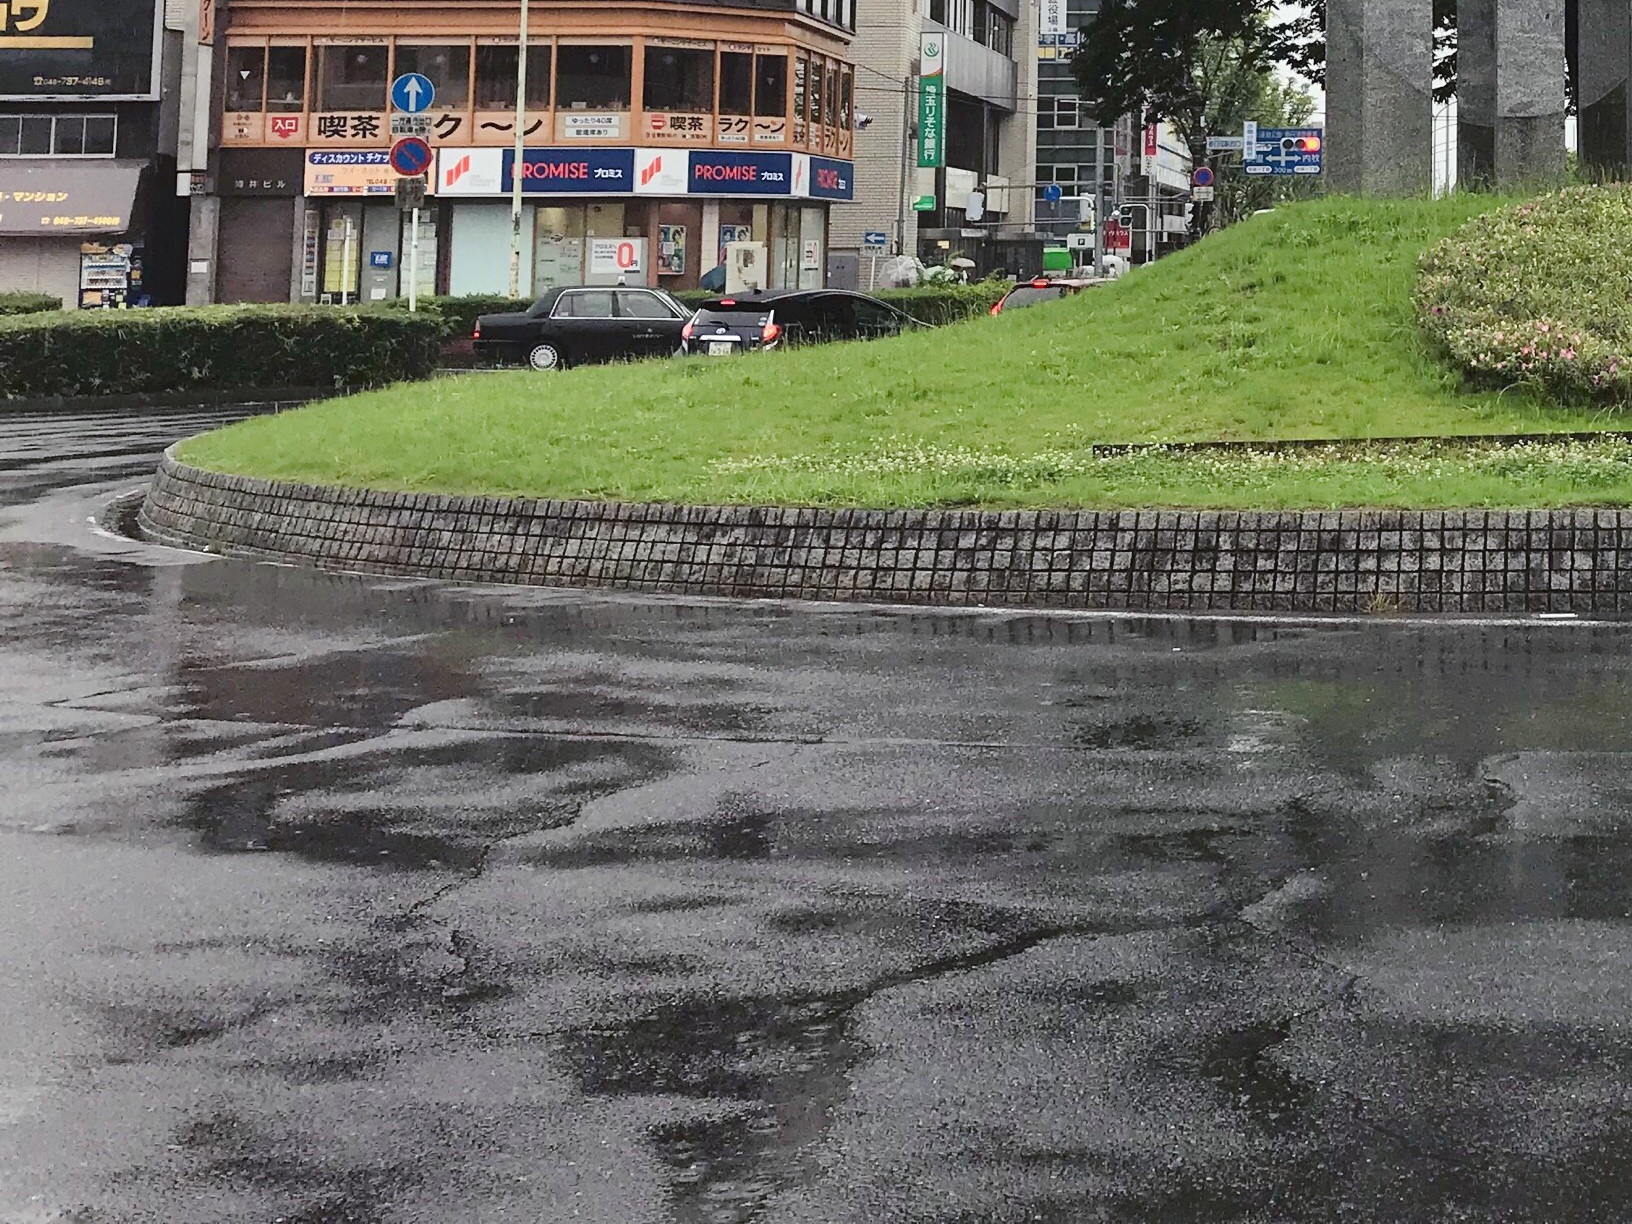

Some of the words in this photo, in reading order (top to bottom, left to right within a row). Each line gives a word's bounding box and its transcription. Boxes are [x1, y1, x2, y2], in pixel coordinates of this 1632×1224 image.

[274, 119, 296, 130] 入口
[317, 115, 380, 138] 喫茶
[670, 116, 703, 131] 喫茶
[924, 85, 936, 161] 埼玉りそな銀行
[593, 167, 623, 179] プロミス
[695, 164, 757, 181] PROMISE
[761, 171, 784, 182] プロミス
